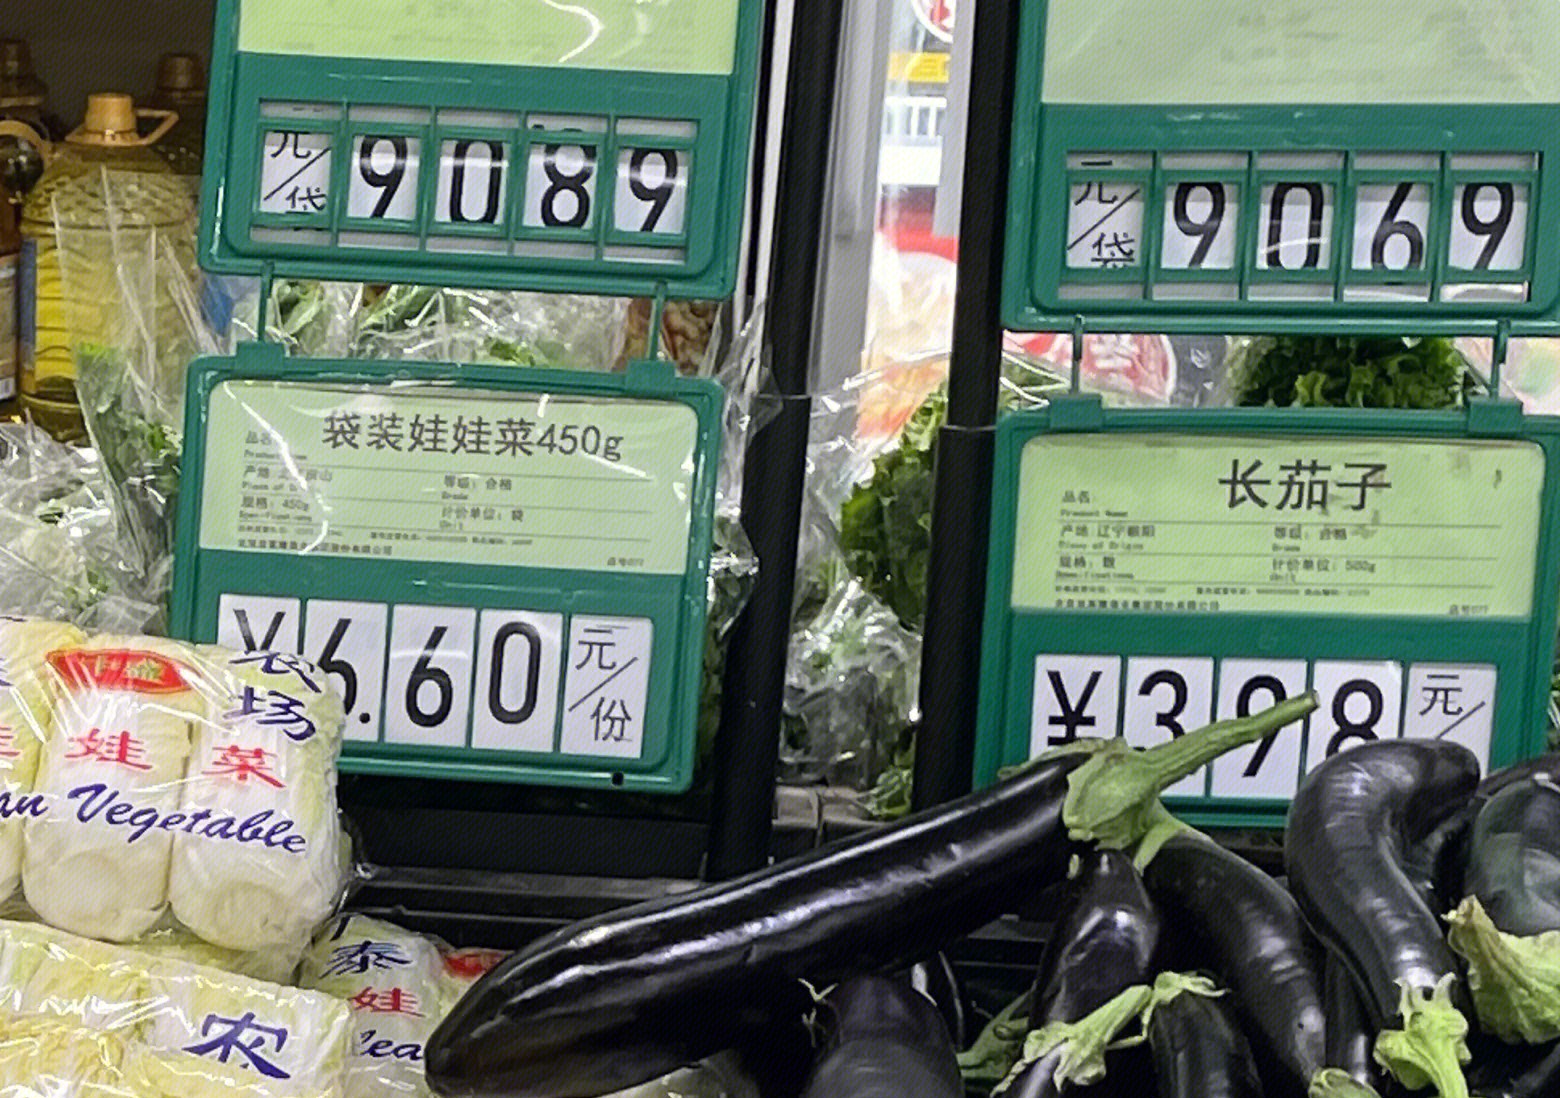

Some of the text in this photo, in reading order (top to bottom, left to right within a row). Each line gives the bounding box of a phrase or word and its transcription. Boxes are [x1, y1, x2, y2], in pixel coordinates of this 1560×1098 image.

[322, 411, 625, 462] 袋装娃娃菜450g
[1218, 459, 1392, 512] 长茄子
[67, 782, 307, 854] Vegetable
